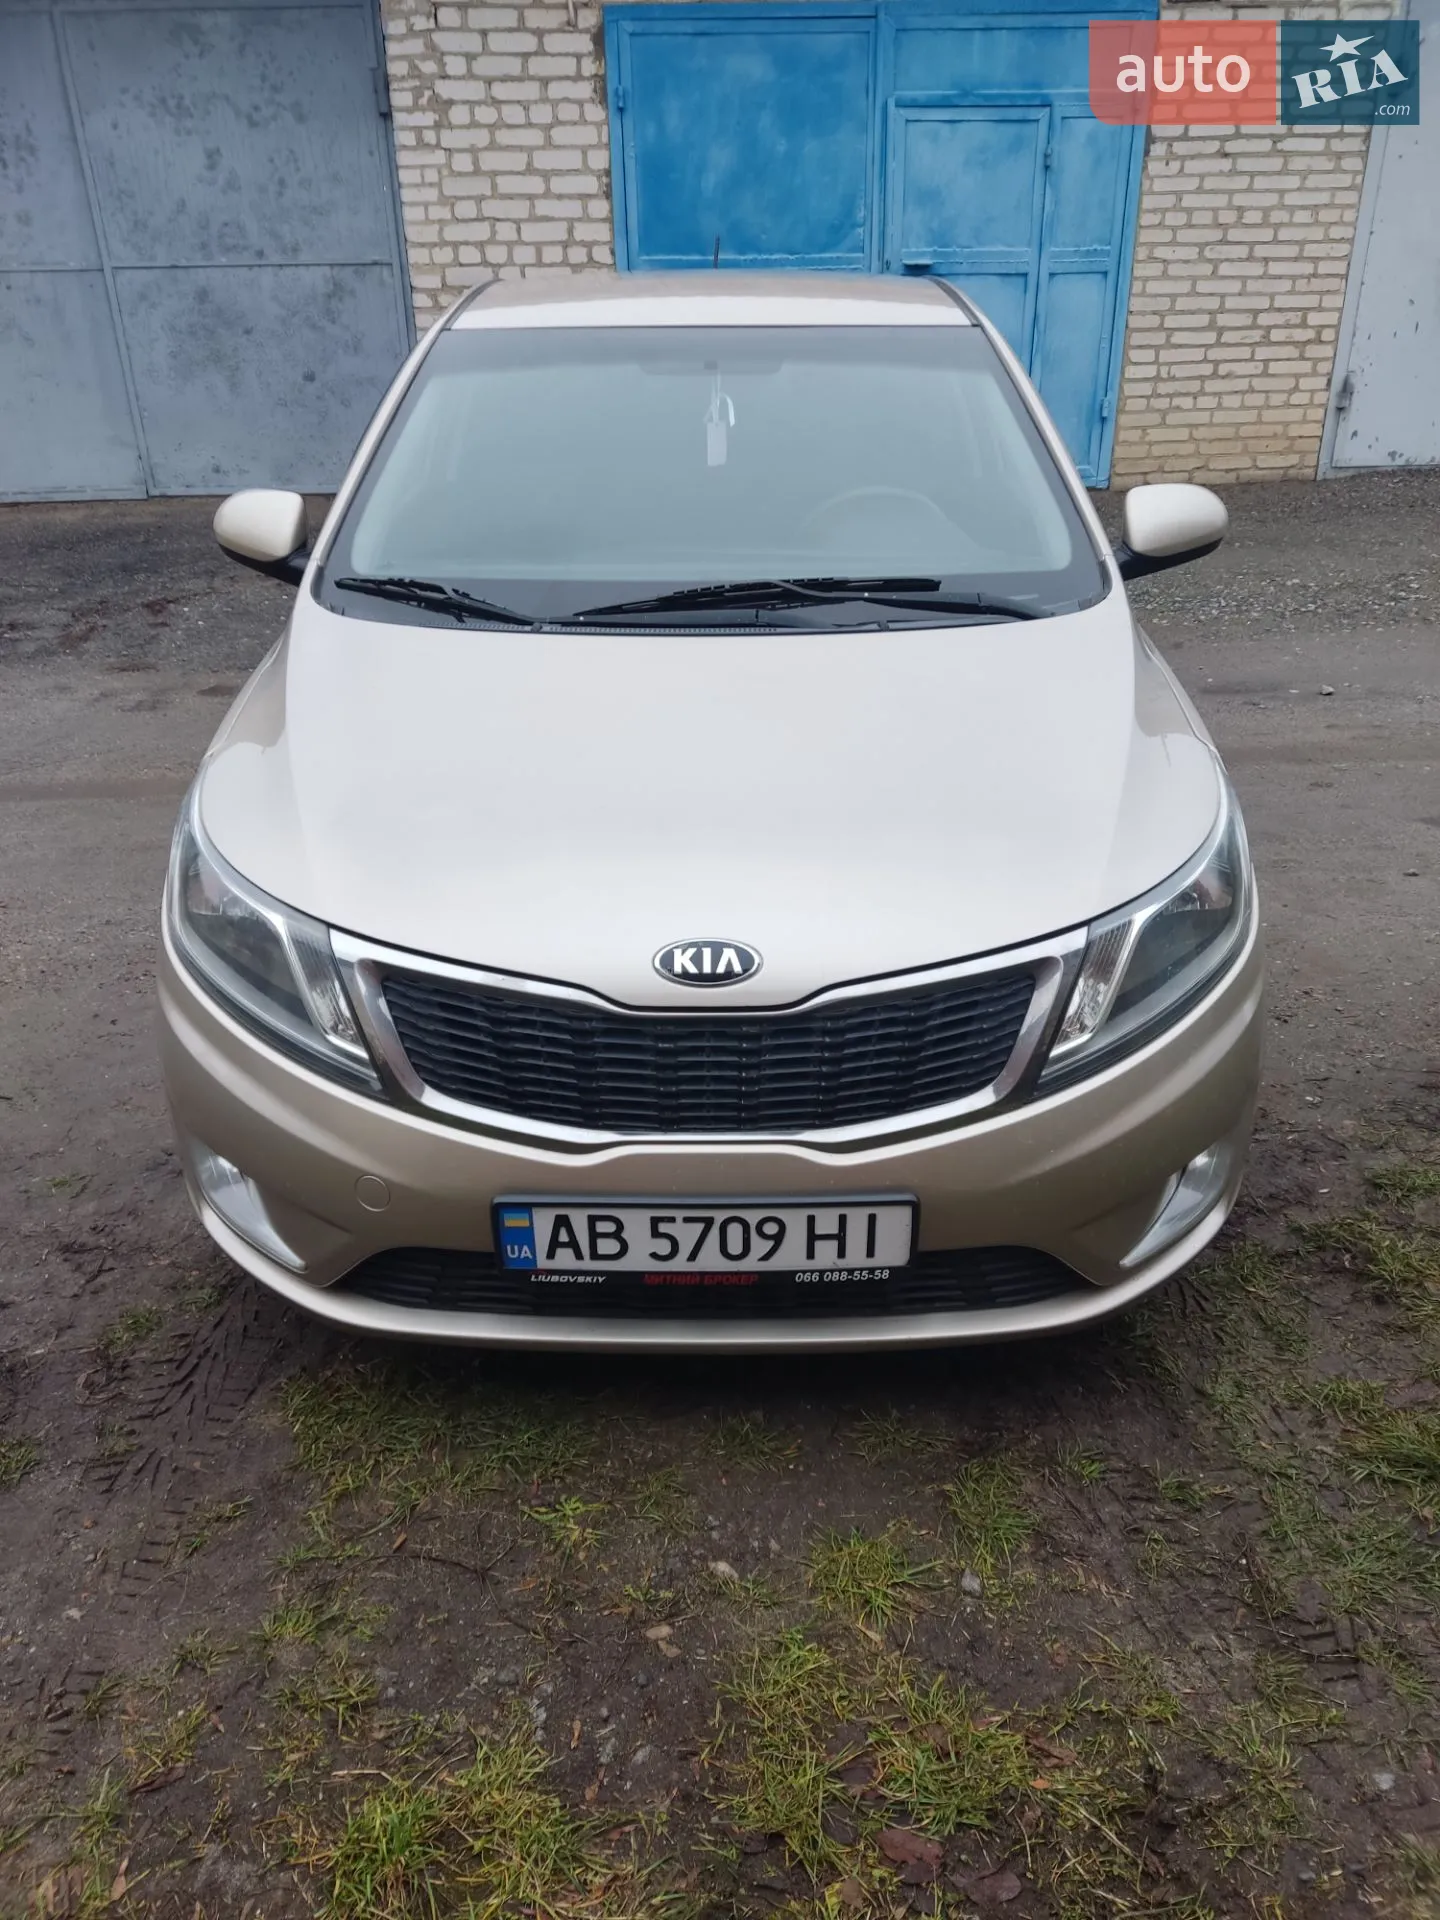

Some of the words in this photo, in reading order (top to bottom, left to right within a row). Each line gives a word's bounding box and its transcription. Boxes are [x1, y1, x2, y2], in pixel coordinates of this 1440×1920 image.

[672, 947, 743, 974] KIA
[545, 1213, 629, 1261] AB
[648, 1214, 787, 1263] 5709
[805, 1213, 877, 1260] HI
[506, 1244, 533, 1259] UA
[530, 1274, 606, 1283] LIUBOVSKIY
[795, 1272, 820, 1283] 066
[823, 1269, 890, 1282] 088-55-58
